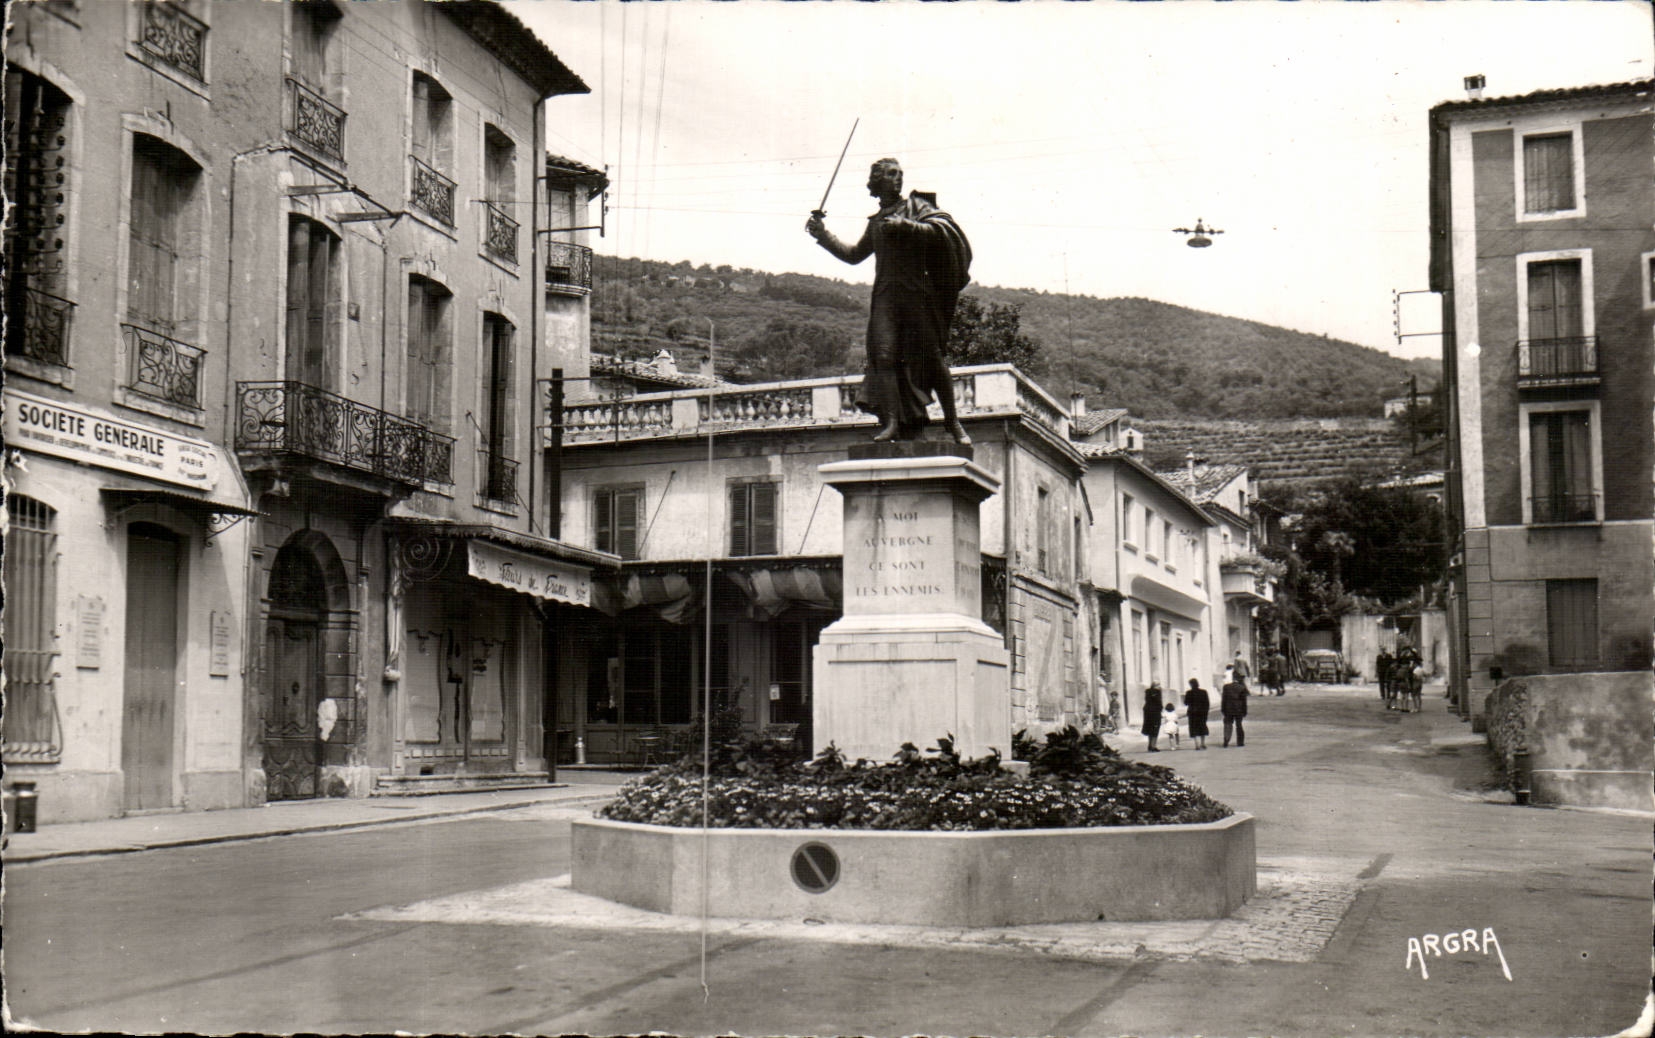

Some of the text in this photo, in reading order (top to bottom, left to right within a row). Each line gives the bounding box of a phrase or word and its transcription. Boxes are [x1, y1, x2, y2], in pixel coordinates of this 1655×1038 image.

[18, 403, 85, 437] SOCIETE
[94, 422, 164, 457] GENERALE
[893, 511, 919, 522] MOI
[863, 535, 934, 548] AUVERGNE
[868, 560, 926, 572] CE SONT
[856, 586, 878, 597] LES
